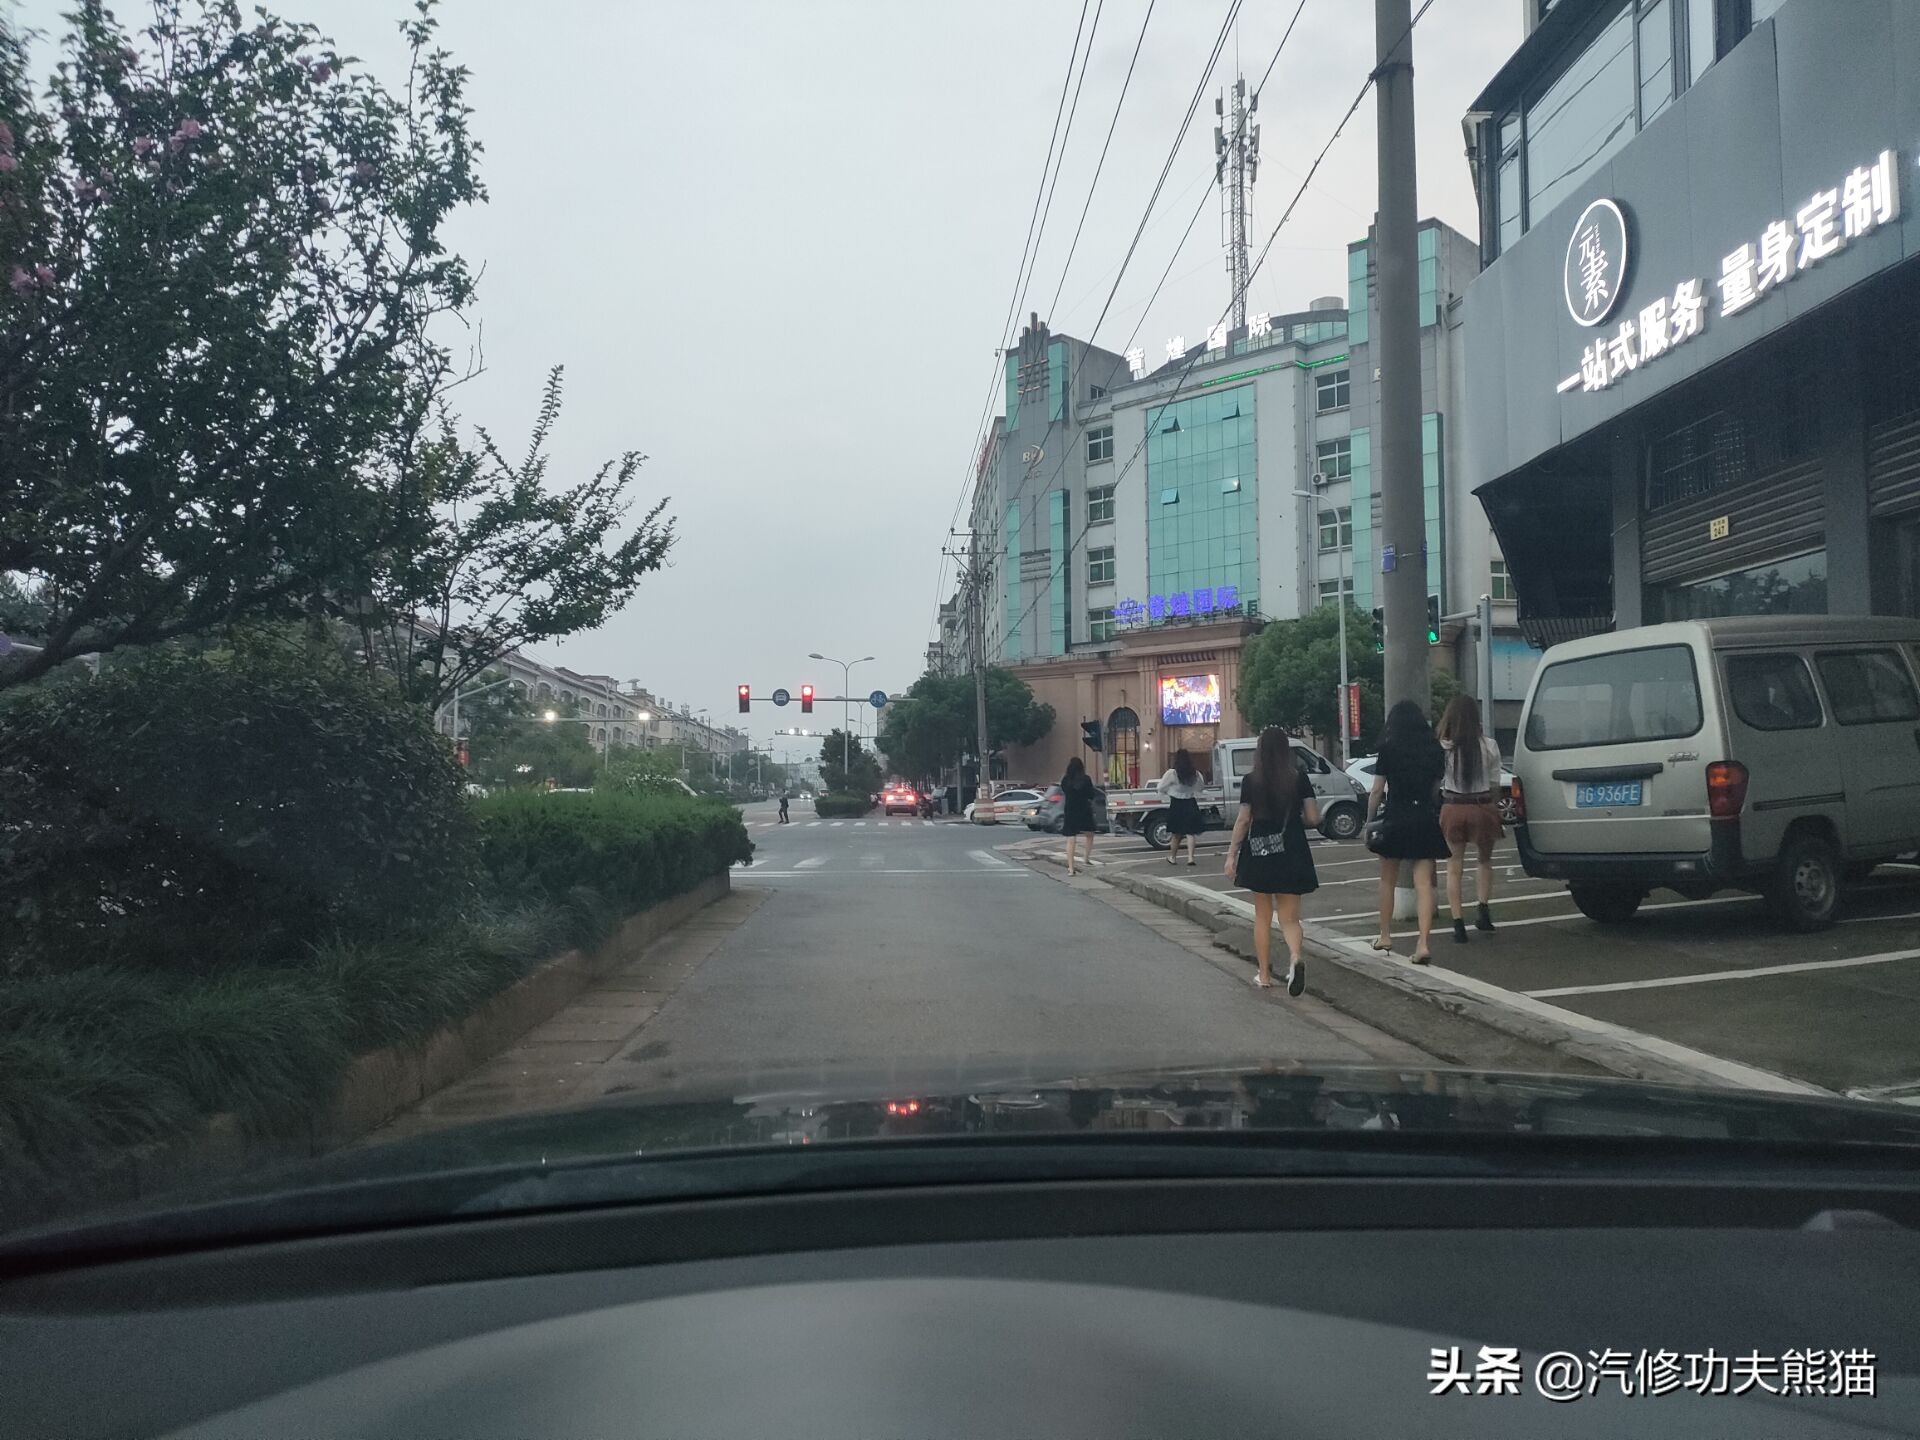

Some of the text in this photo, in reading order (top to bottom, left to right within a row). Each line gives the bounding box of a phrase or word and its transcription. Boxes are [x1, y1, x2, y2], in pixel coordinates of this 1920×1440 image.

[1556, 149, 1899, 394] 一站式服务 量身定制
[1579, 225, 1608, 315] 元素
